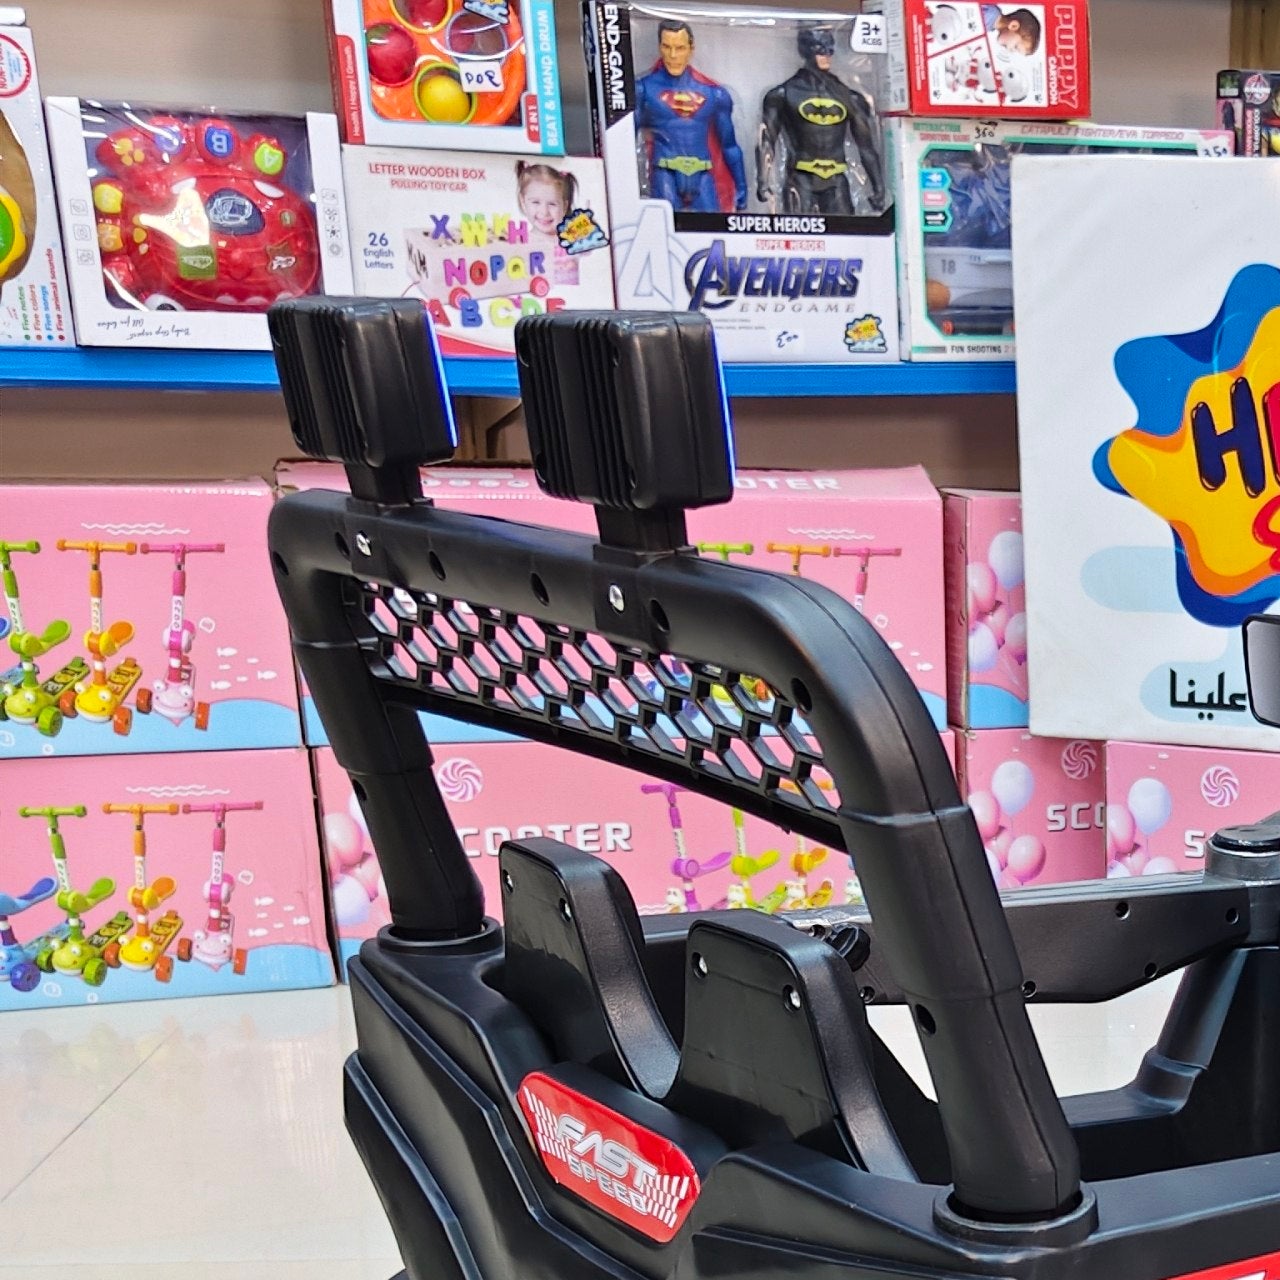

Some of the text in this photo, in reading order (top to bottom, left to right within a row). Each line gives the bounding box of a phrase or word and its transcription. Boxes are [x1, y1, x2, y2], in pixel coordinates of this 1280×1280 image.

[861, 21, 880, 36] 3+
[604, 4, 626, 111] END-GAME
[1054, 4, 1079, 110] PUPPY
[539, 10, 559, 147] BEAT & HAND DRUM
[369, 163, 486, 180] LETTER WOODEN BOX
[391, 179, 467, 191] PULLING TOY CAR
[727, 218, 826, 233] SUPER HEROES
[368, 232, 388, 247] 26
[363, 249, 394, 259] English
[364, 259, 394, 270] Letters
[686, 239, 862, 311] AVENGERS
[740, 303, 856, 312] ENDGAME
[950, 346, 964, 354] FUN
[967, 346, 1002, 355] SHOOTING
[735, 477, 839, 490] OTER
[556, 1114, 658, 1190] FAST
[567, 1152, 650, 1216] SPEED
